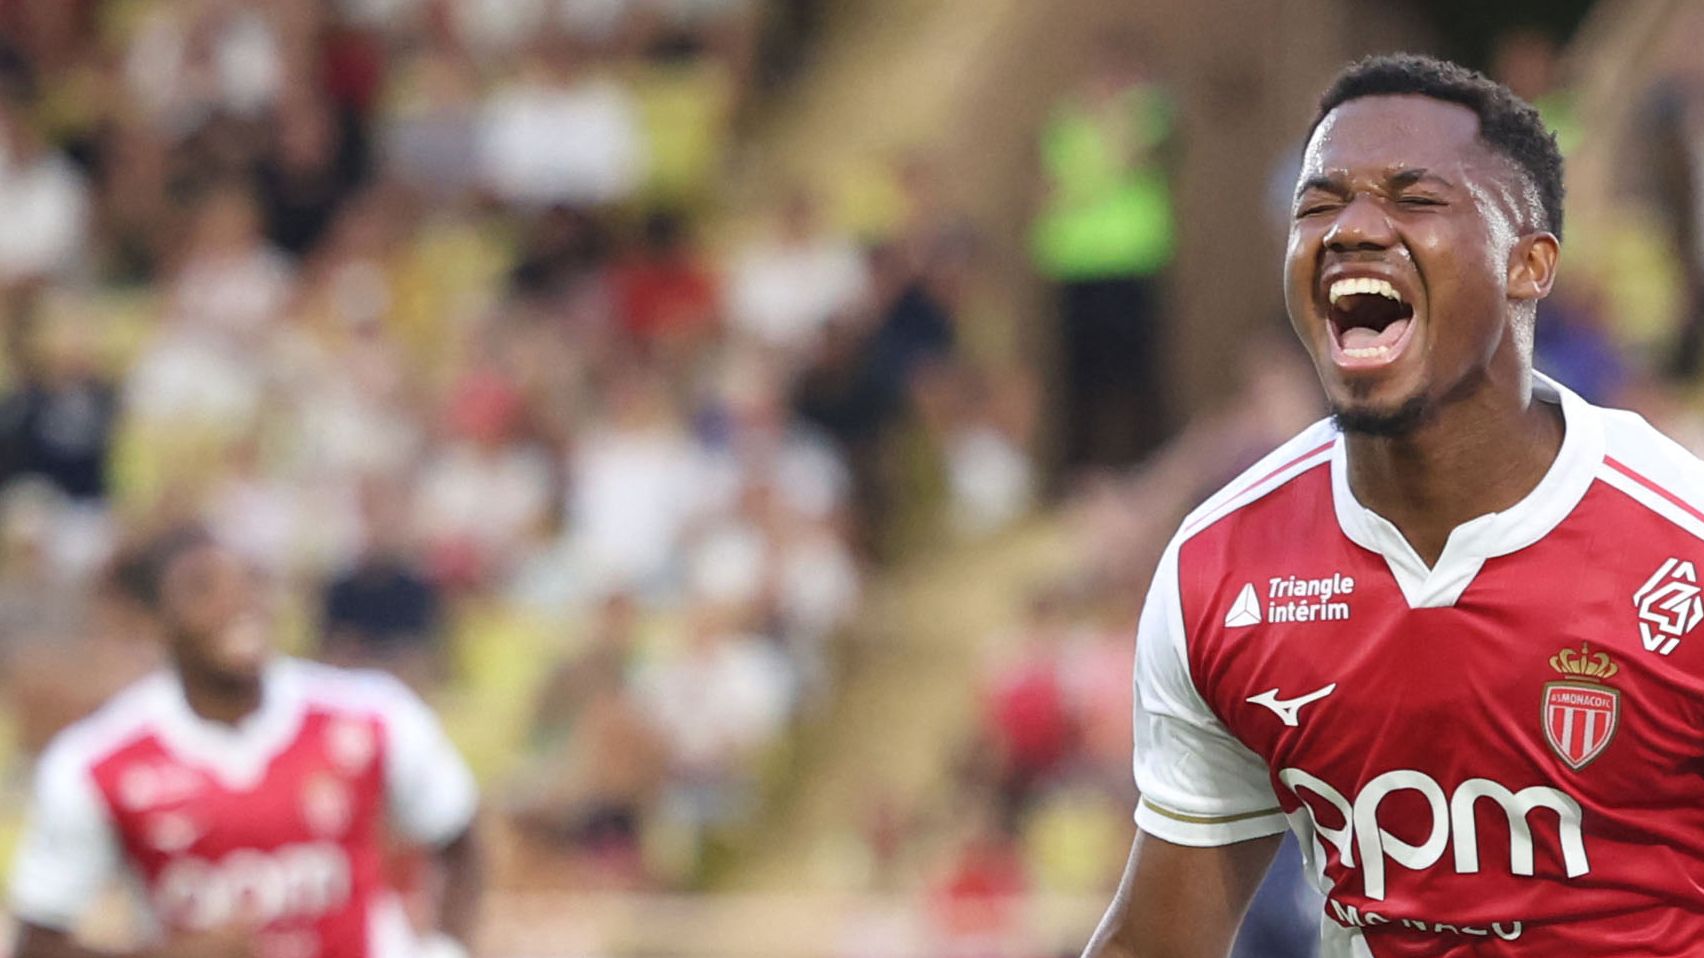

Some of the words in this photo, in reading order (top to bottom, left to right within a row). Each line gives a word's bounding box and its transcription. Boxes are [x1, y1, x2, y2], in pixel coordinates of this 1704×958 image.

[1268, 572, 1354, 600] Triangle
[1268, 600, 1349, 623] intérim
[1279, 768, 1590, 901] apm
